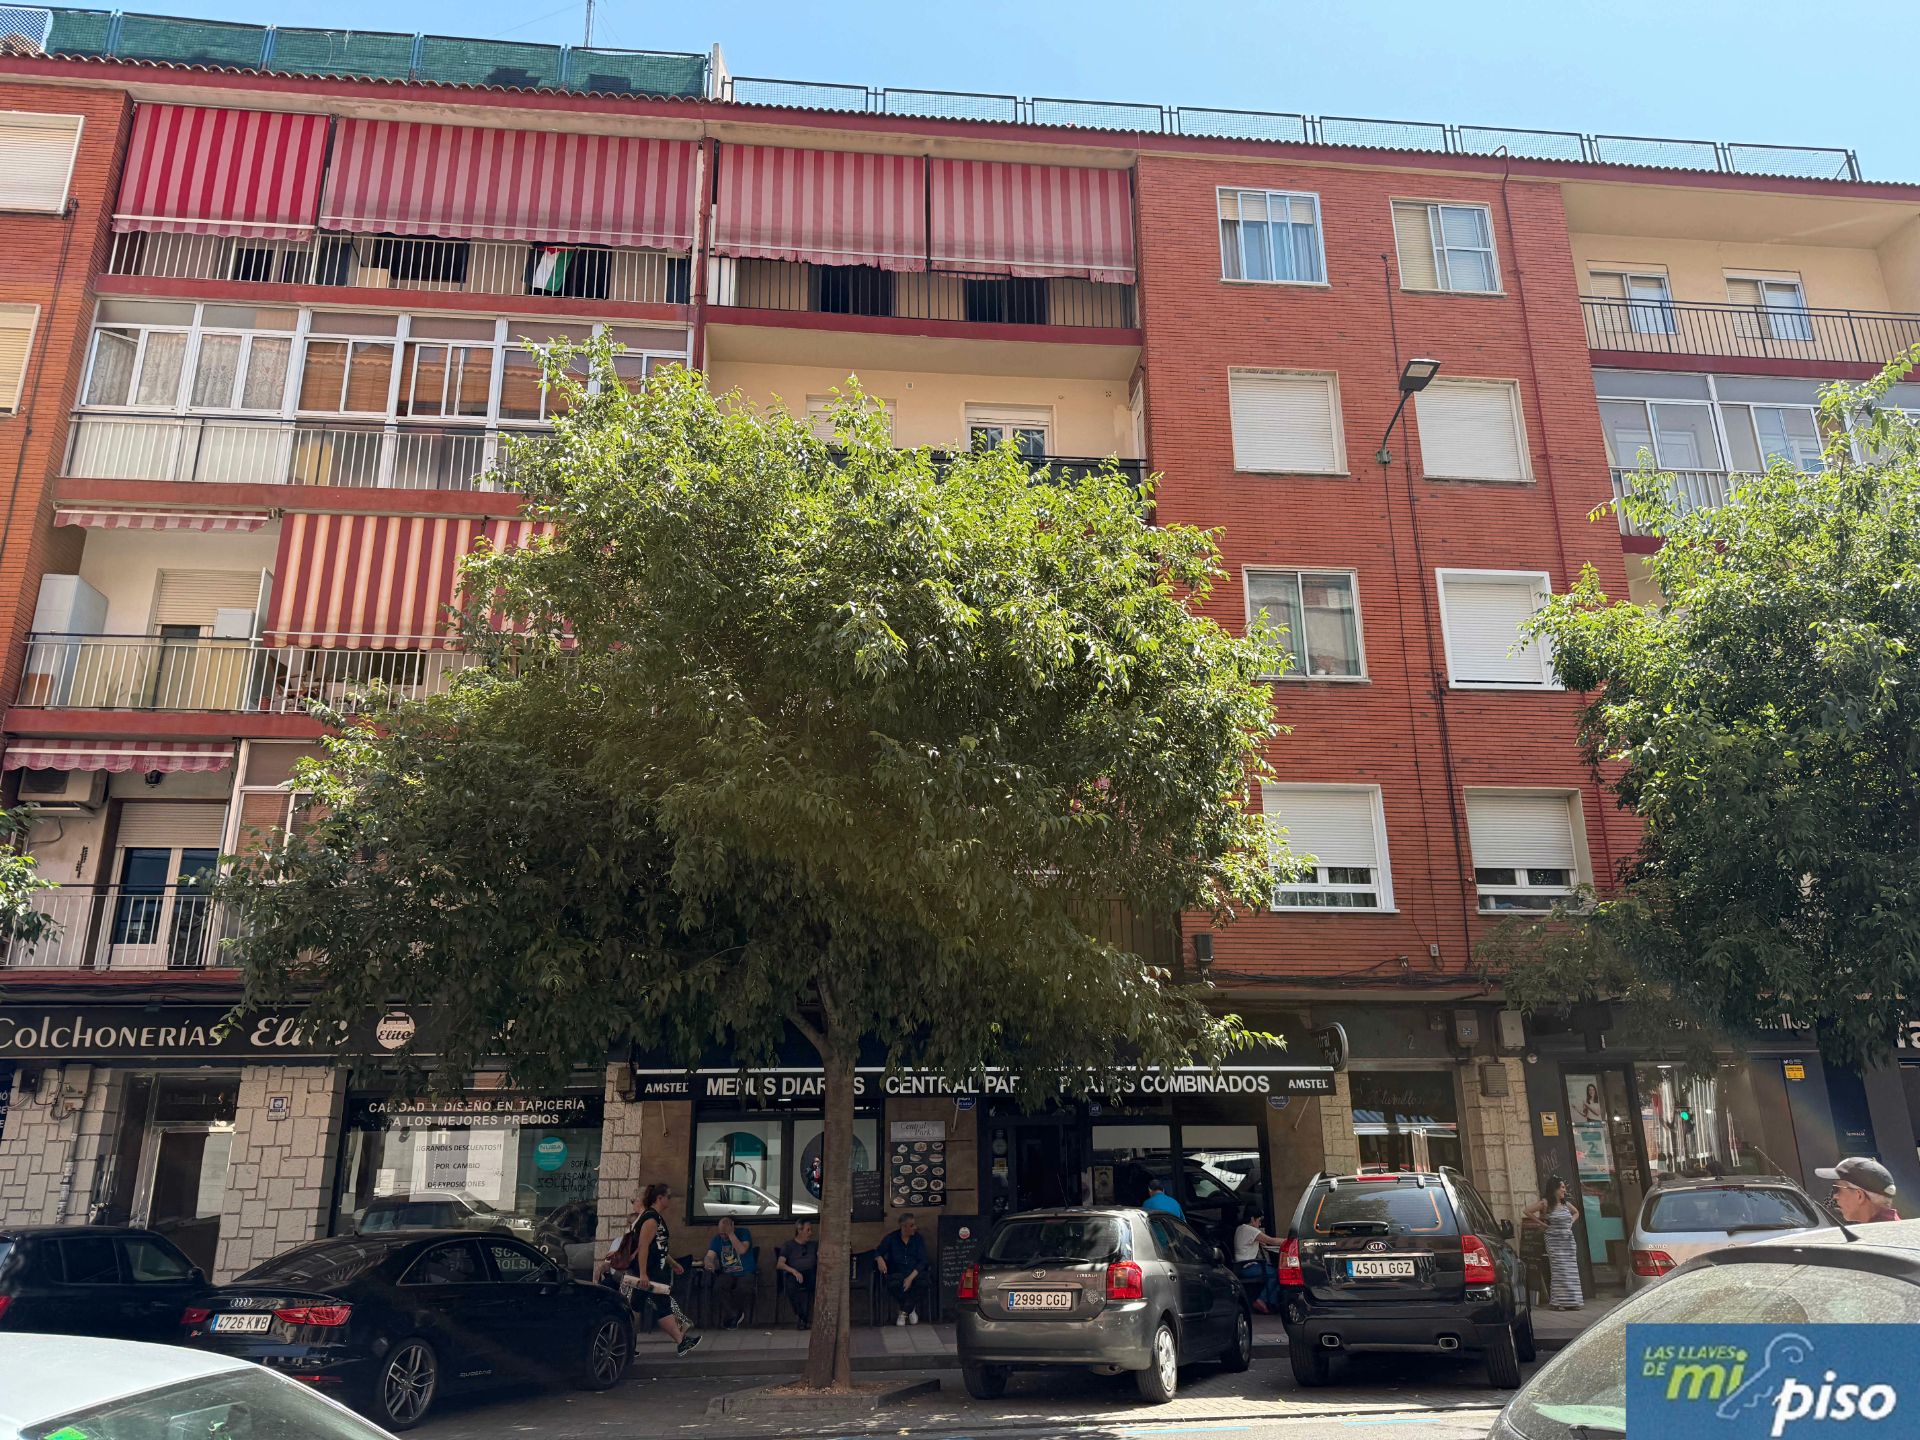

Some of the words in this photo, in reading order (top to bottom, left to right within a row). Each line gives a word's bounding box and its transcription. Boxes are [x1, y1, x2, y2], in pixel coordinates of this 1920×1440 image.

[644, 1082, 689, 1094] AMSTEL
[782, 1076, 865, 1095] DIARS
[984, 1075, 1027, 1094] PAR
[1140, 1075, 1271, 1093] COMBINADOS
[1288, 1079, 1329, 1089] AMSTEL
[431, 1102, 438, 1111] Y
[497, 1101, 514, 1111] EN
[519, 1098, 585, 1111] TAPICERÍA
[392, 1115, 401, 1126] A
[407, 1115, 433, 1126] LOS
[437, 1114, 498, 1126] MEJORES
[503, 1113, 560, 1125] PRECIOS
[435, 1162, 450, 1170] POR
[452, 1162, 481, 1170] CAMBIO
[1355, 1262, 1385, 1275] 4501
[1389, 1262, 1413, 1274] GGZ
[1014, 1294, 1042, 1306] 2999
[1046, 1294, 1068, 1306] CGD
[217, 1316, 244, 1329] 4726
[245, 1316, 269, 1329] KWB
